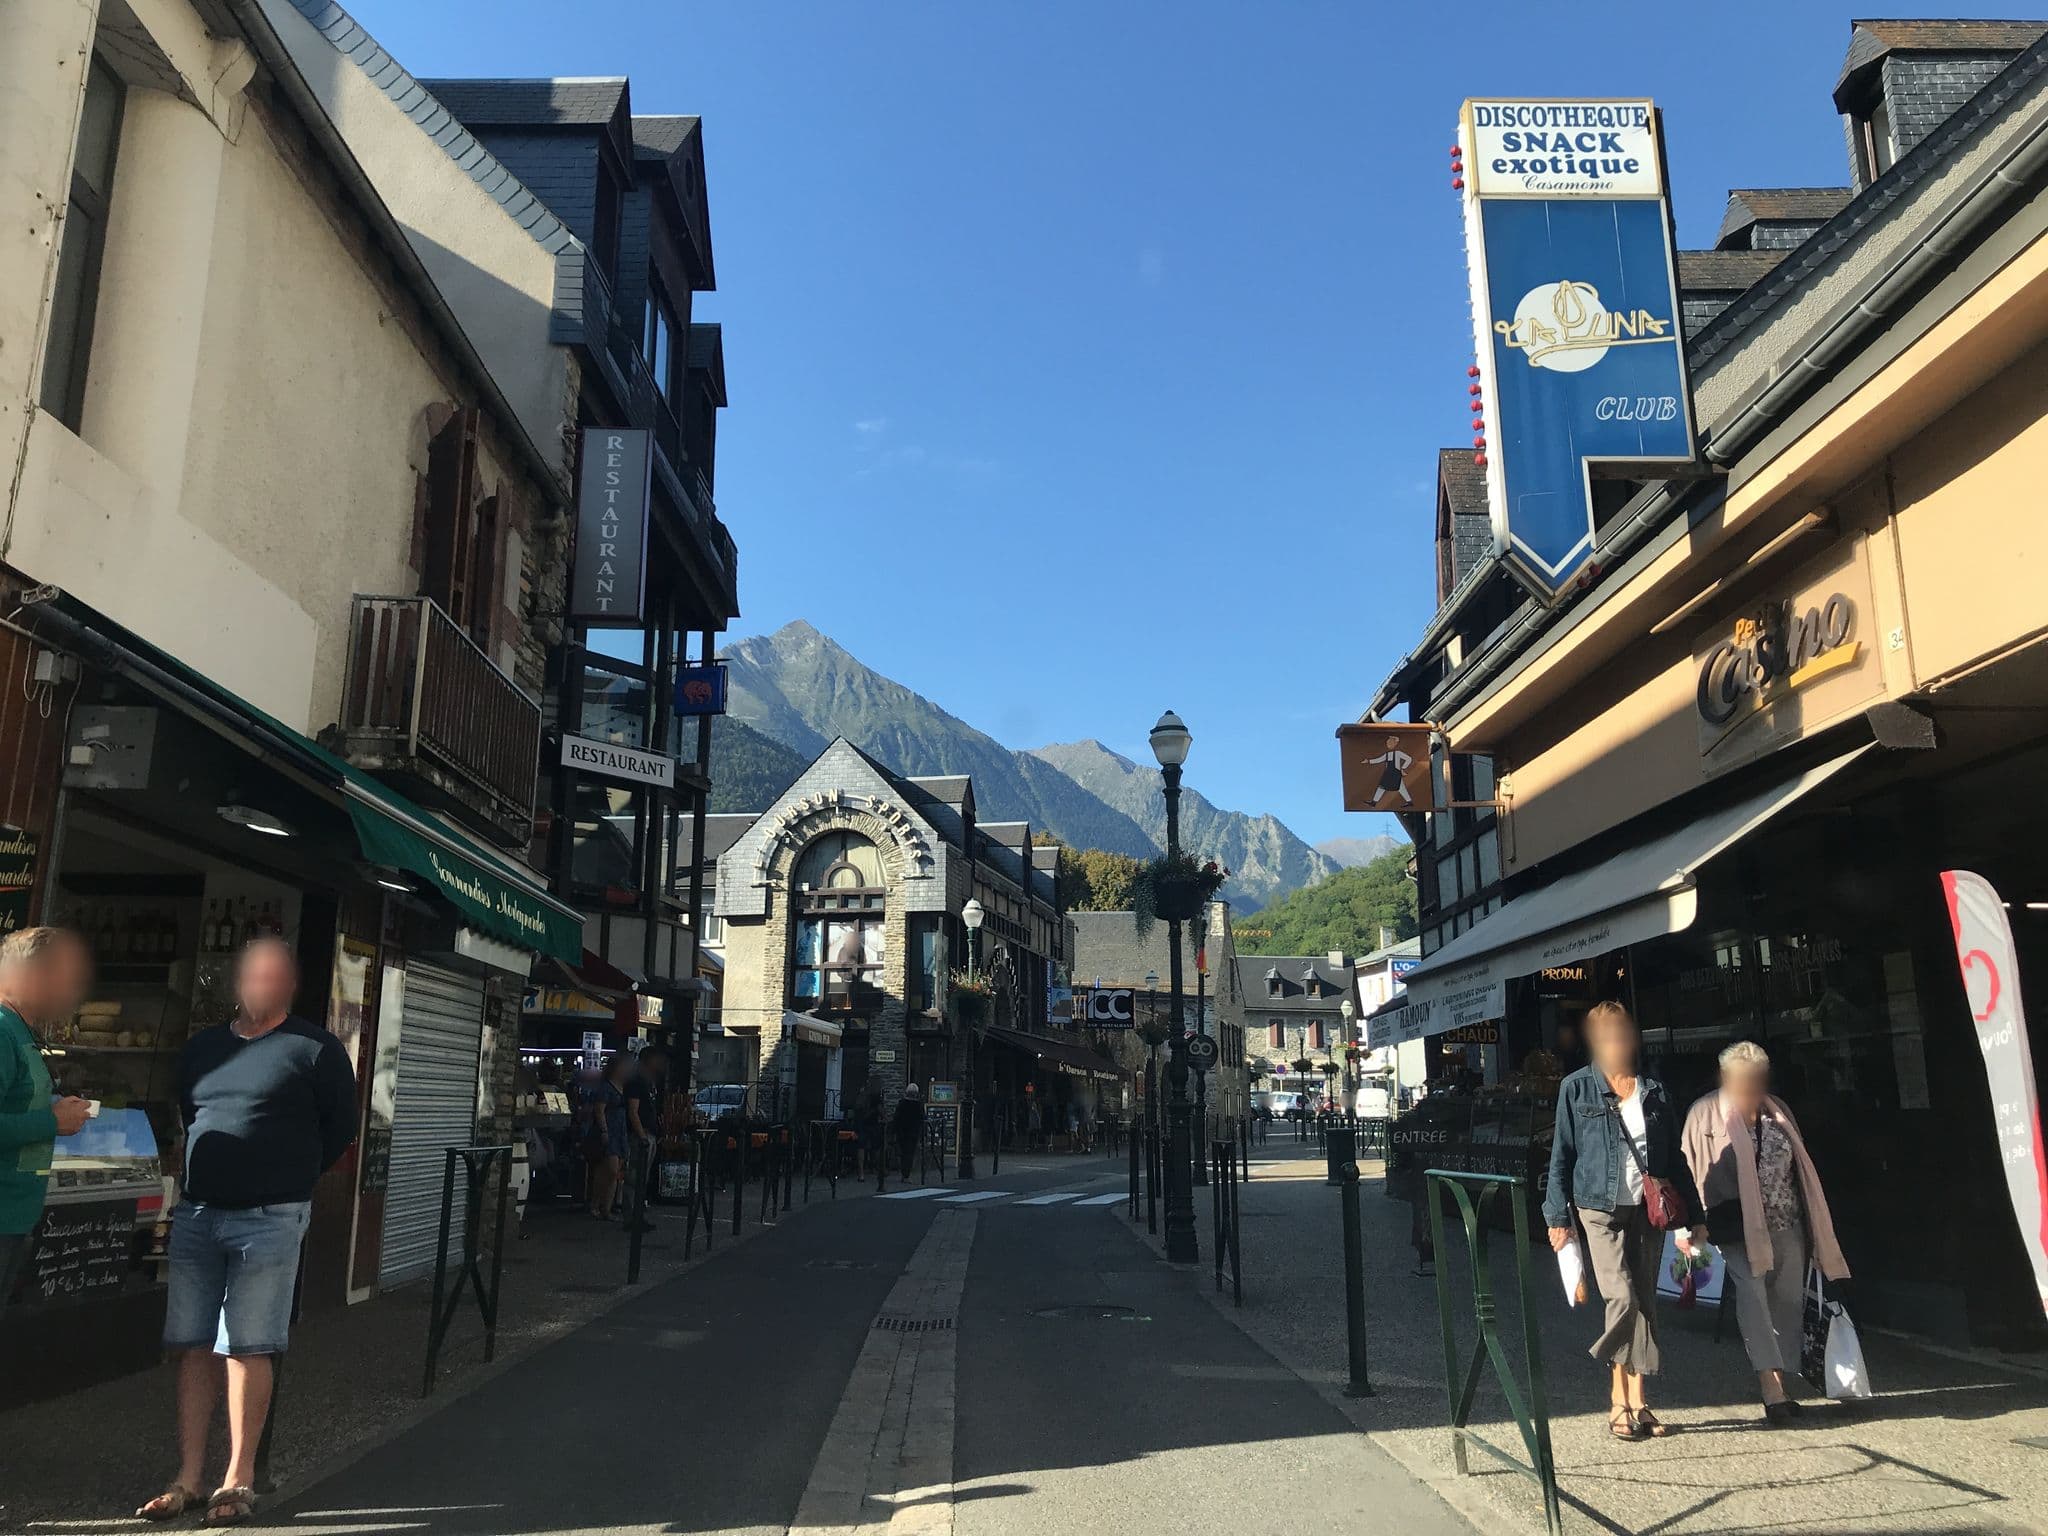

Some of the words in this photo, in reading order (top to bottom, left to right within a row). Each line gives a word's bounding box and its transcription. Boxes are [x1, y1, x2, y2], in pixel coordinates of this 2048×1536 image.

[1474, 106, 1647, 128] DISCOTHEQUE
[1502, 132, 1625, 153] SNACK
[1491, 154, 1639, 179] exotique
[1522, 175, 1613, 190] Casamomo
[1595, 396, 1677, 421] CLUB
[594, 434, 626, 613] RESTAURANT
[570, 744, 667, 779] RESTAURANT
[1394, 962, 1416, 972] L'O
[1541, 968, 1587, 981] PRODUI
[1447, 1028, 1498, 1043] CHAUD
